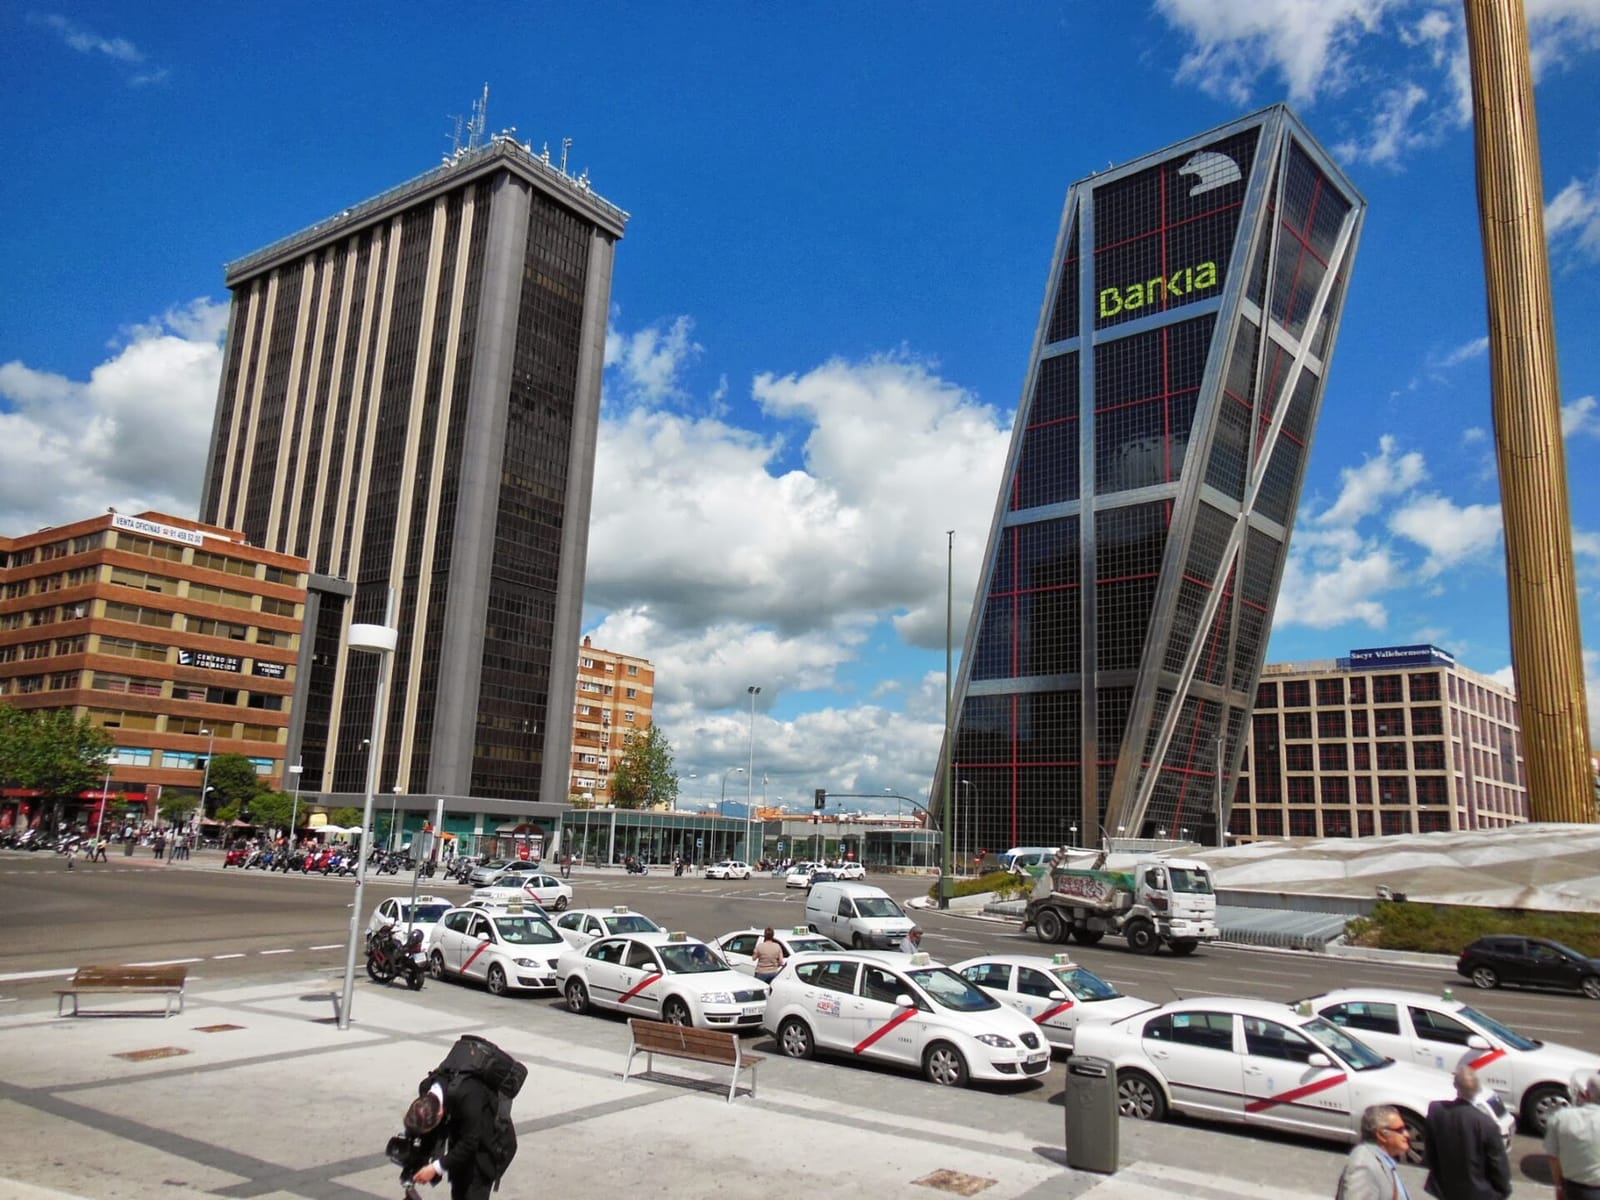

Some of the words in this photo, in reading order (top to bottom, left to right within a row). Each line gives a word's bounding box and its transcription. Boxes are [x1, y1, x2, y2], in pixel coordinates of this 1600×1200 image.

[1100, 261, 1217, 318] Bankia
[116, 516, 134, 527] VENTA
[135, 521, 161, 534] OFICINAS
[197, 653, 225, 663] CENTRO
[1351, 651, 1373, 660] Sacyr
[1375, 648, 1430, 659] Vallehermoso
